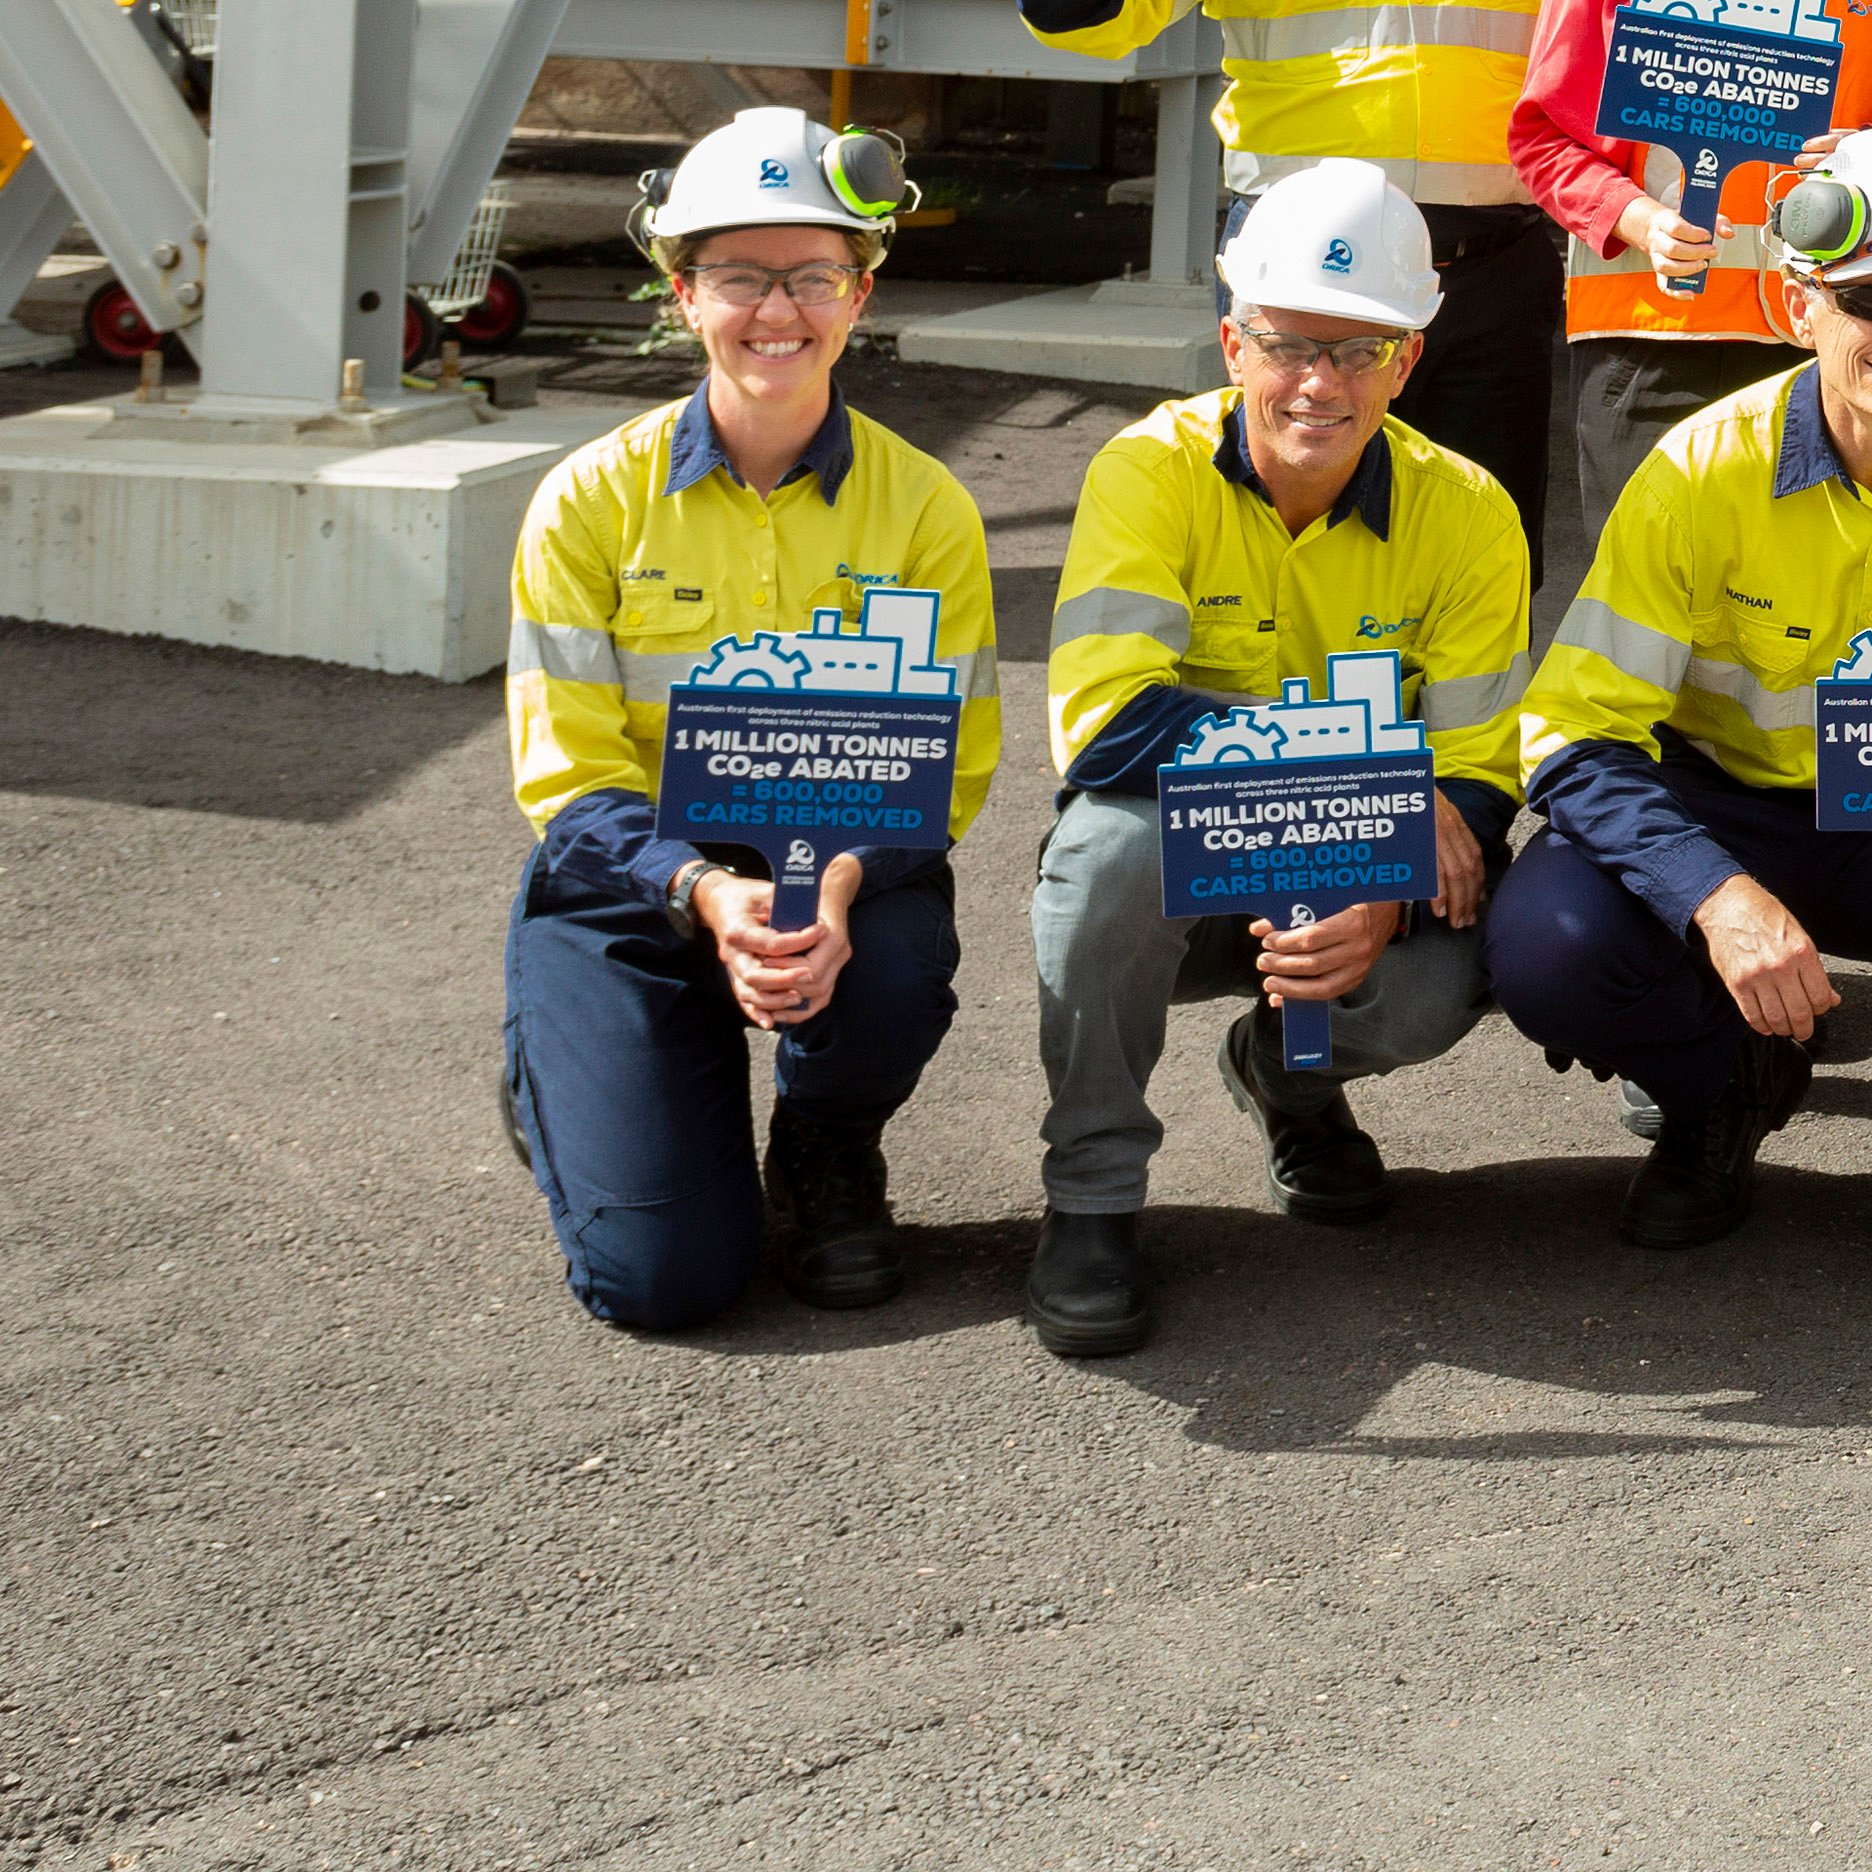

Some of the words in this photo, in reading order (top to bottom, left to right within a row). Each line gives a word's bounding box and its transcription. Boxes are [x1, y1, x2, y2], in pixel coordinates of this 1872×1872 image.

[1321, 263, 1350, 274] ORICA
[621, 568, 666, 581] CLARE
[1197, 595, 1242, 607] ANDRE
[1725, 586, 1773, 610] NATHAN
[674, 728, 689, 750] 1
[695, 729, 822, 755] MILLION
[826, 734, 948, 759] TONNES
[1825, 722, 1839, 743] 1
[787, 757, 911, 782] ABATED
[753, 780, 883, 805] 600,000
[686, 801, 768, 825] CARS
[774, 804, 922, 829] REMOVED
[1169, 808, 1184, 830] 1
[1188, 800, 1307, 829] MILLION
[1310, 791, 1427, 820] TONNES
[1279, 817, 1395, 846] ABATED
[1250, 842, 1372, 871] 600,000
[1189, 873, 1267, 898] CARS
[1273, 862, 1412, 893] REMOVED
